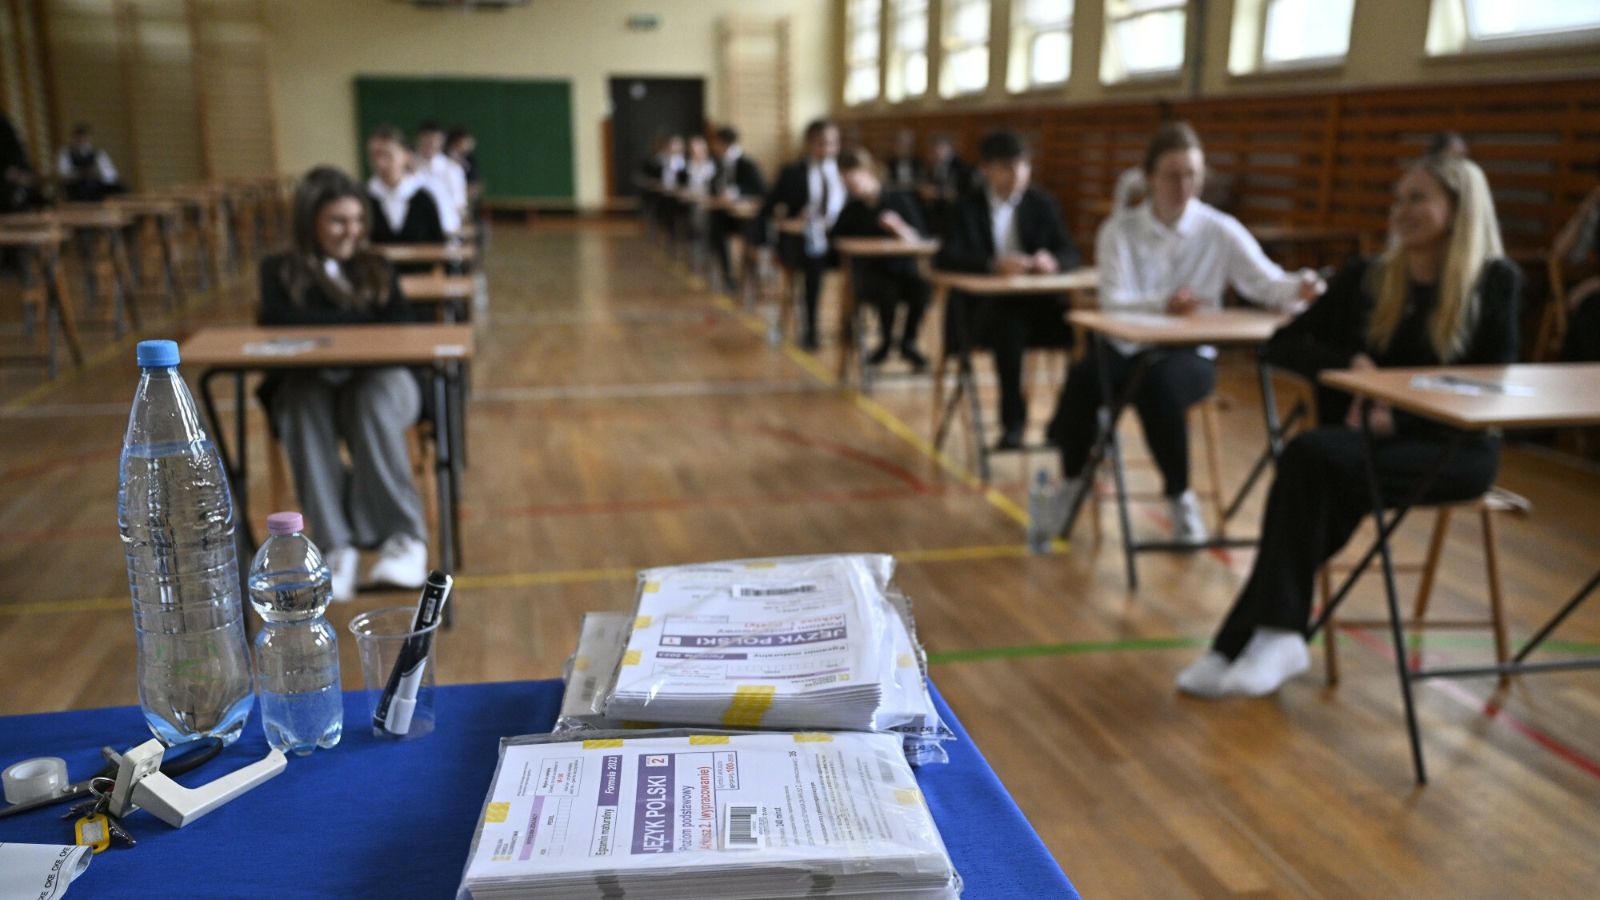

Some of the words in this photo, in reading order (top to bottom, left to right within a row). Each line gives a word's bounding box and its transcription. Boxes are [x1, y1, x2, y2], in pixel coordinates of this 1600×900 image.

[695, 636, 772, 647] POLSKI
[779, 627, 845, 645] JĘZYK
[645, 775, 667, 818] POLSKI
[679, 785, 695, 828] podstawowy
[697, 766, 714, 821] (wypracowanie)
[600, 808, 615, 834] maturalny
[643, 819, 670, 853] JĘZYK
[679, 829, 692, 851] Poziom
[45, 874, 55, 889] CKE
[52, 859, 63, 872] CKE
[60, 847, 71, 857] CKE
